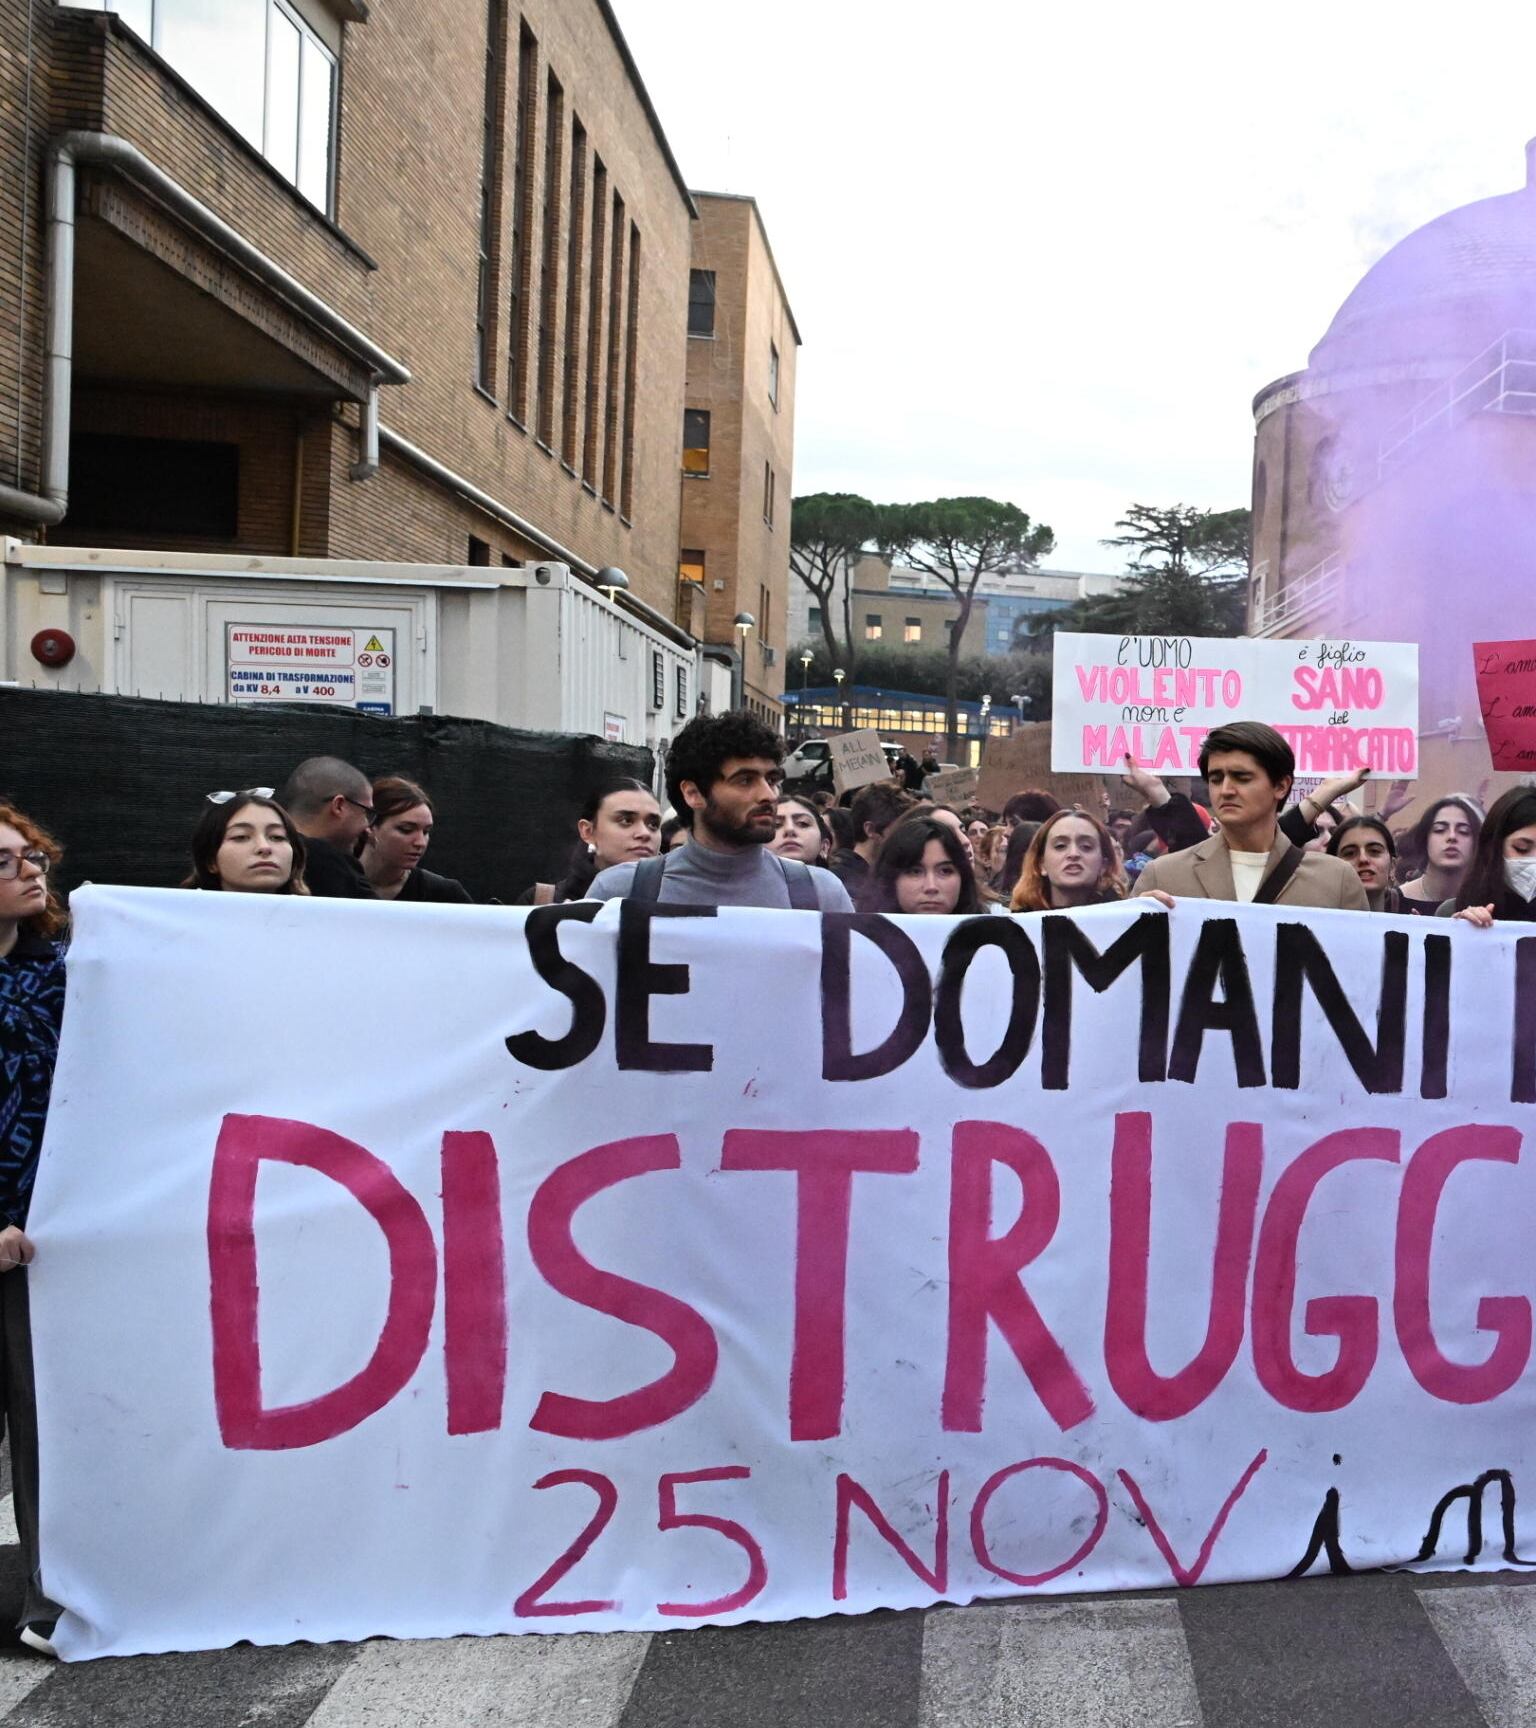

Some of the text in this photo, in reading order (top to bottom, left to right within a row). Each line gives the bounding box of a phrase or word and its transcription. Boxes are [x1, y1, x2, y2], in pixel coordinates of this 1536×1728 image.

[233, 633, 352, 646] ATTENZIONE ALTA TENSIONE
[249, 646, 337, 658] PERICOLO DI MORTE
[1317, 642, 1367, 670] figlio
[231, 671, 264, 681] CABINA
[266, 672, 275, 681] DI
[277, 672, 355, 684] TRASFORMAZIONE
[1291, 665, 1384, 711] SANO
[233, 683, 336, 697] da KV 8,4 a V 400
[1328, 711, 1350, 726] del
[1082, 724, 1209, 769] MALAT
[504, 897, 719, 1072] SE
[821, 911, 1452, 1100] DOMANI
[513, 1465, 768, 1618] 25
[832, 1447, 1269, 1601] NOV
